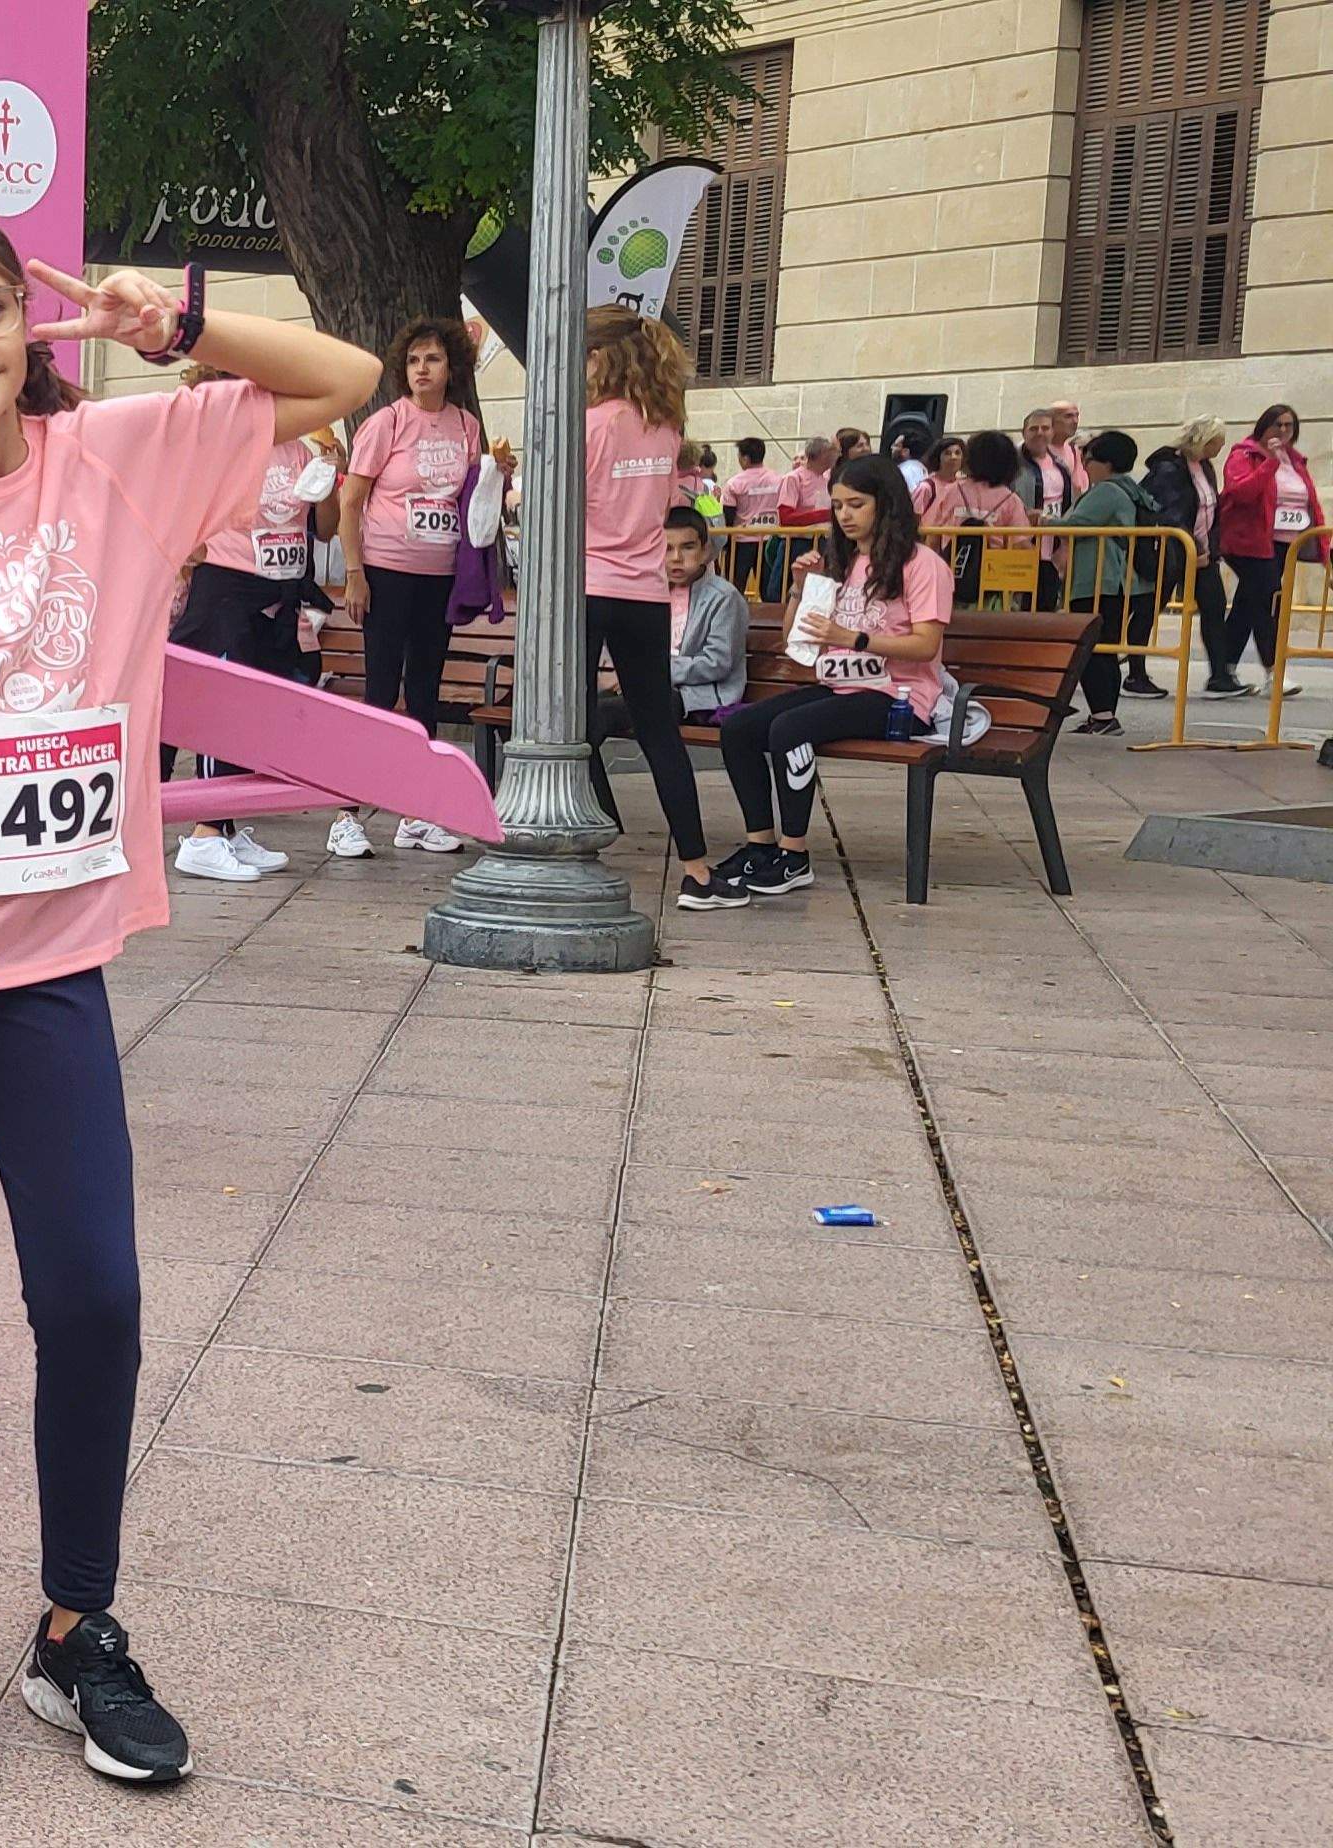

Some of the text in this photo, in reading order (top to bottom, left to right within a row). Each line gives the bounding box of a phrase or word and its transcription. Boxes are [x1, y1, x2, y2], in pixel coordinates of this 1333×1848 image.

[414, 511, 460, 533] 2092
[263, 546, 305, 567] 2098
[824, 658, 882, 678] 2110
[16, 735, 69, 753] HUESCA
[36, 753, 56, 769] EL
[59, 742, 116, 767] CÁNCER
